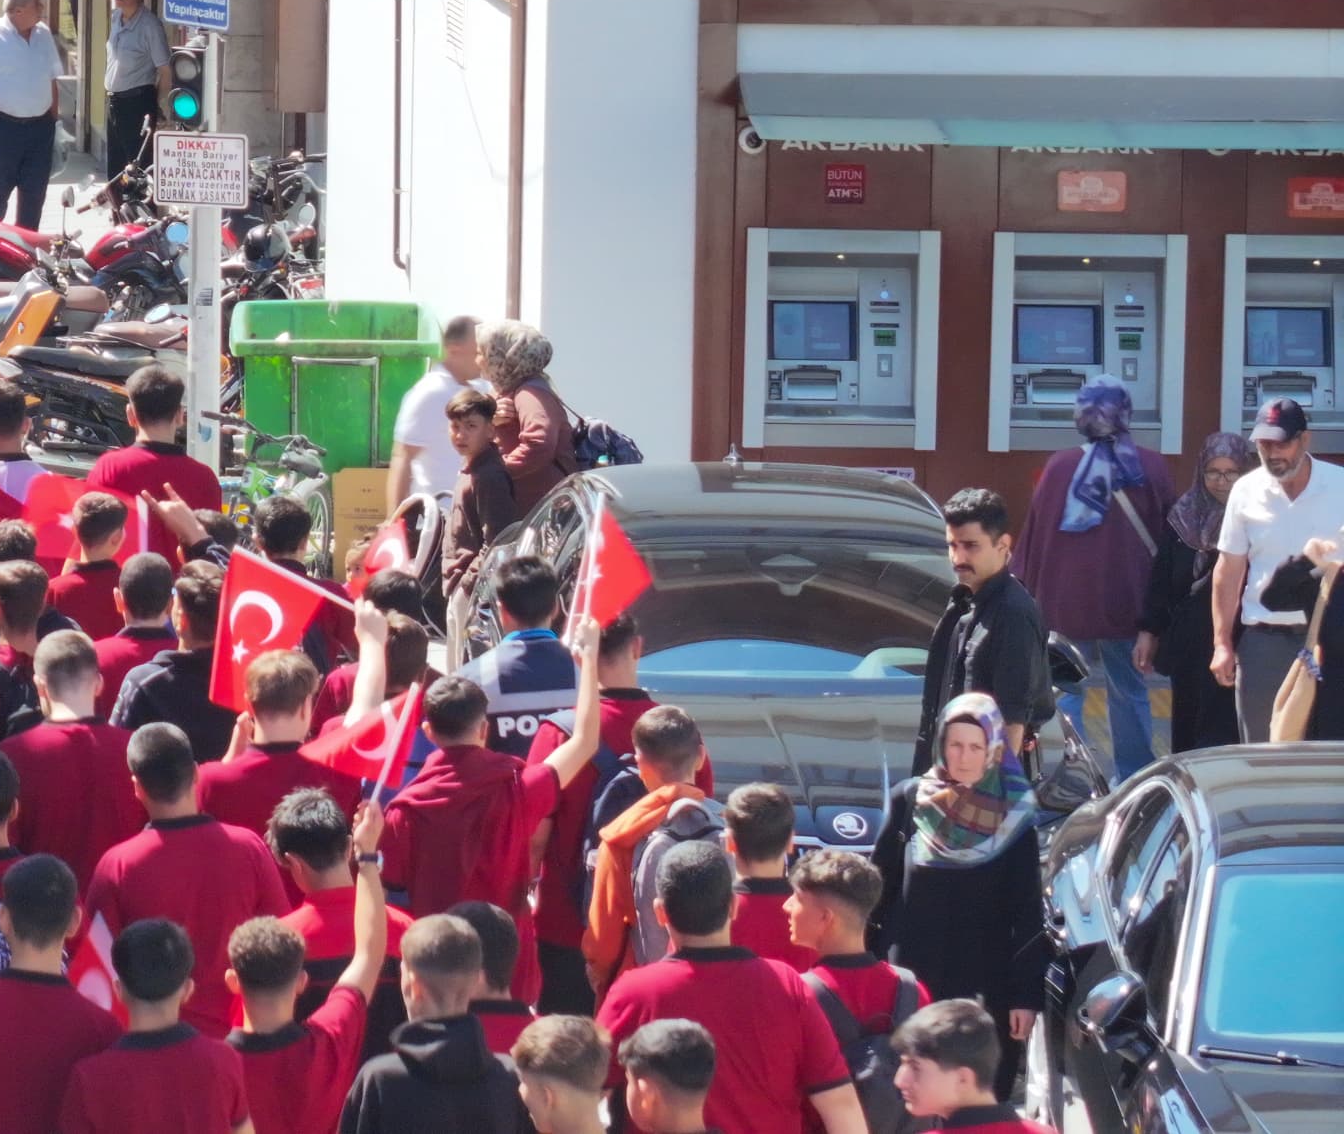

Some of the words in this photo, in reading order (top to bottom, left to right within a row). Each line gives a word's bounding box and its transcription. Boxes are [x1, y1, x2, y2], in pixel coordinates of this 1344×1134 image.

[176, 139, 217, 150] DİKKAT
[163, 148, 197, 158] Mantar
[202, 150, 238, 161] Bariyer
[201, 161, 225, 169] sonra
[160, 167, 241, 182] KAPANACAKTIR
[827, 169, 862, 180] BÜTÜN
[160, 178, 196, 190] Bariyer
[160, 188, 196, 201] DURMAK
[199, 190, 241, 203] YASAKTIR
